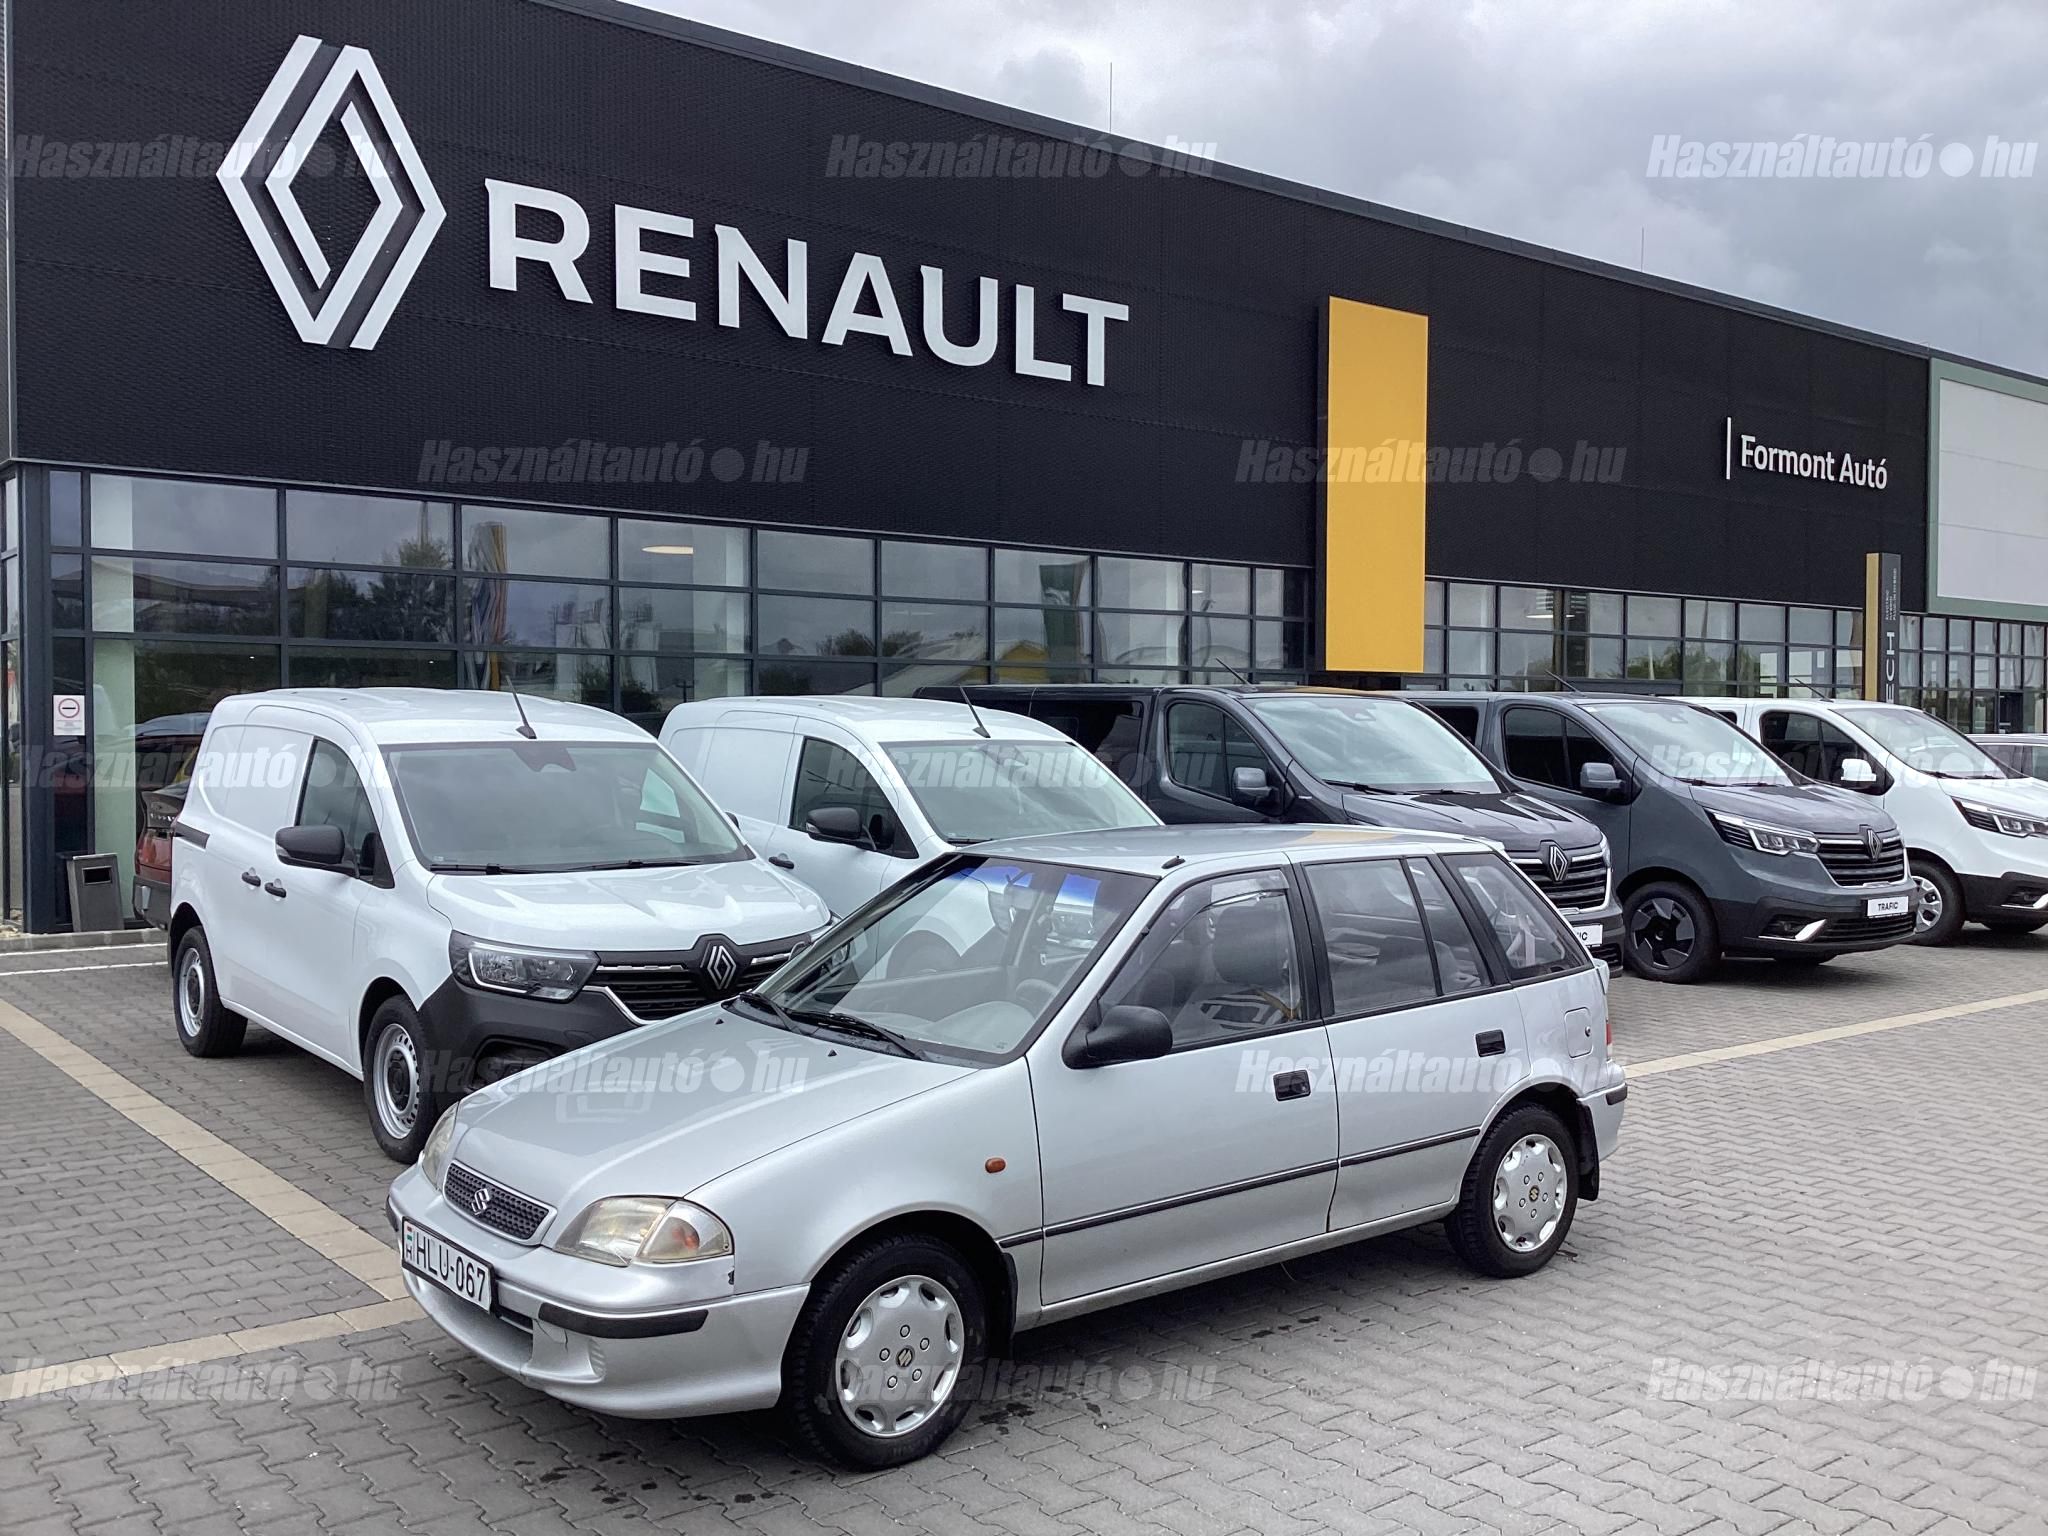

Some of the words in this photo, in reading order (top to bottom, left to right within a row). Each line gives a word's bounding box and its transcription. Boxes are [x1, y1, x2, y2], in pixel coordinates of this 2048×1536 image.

[485, 178, 1129, 387] RENAULT
[1741, 434, 1834, 481] Formont
[1839, 453, 1888, 490] Autó
[1877, 902, 1899, 911] TRAFIC
[416, 1231, 486, 1302] HLU-067
